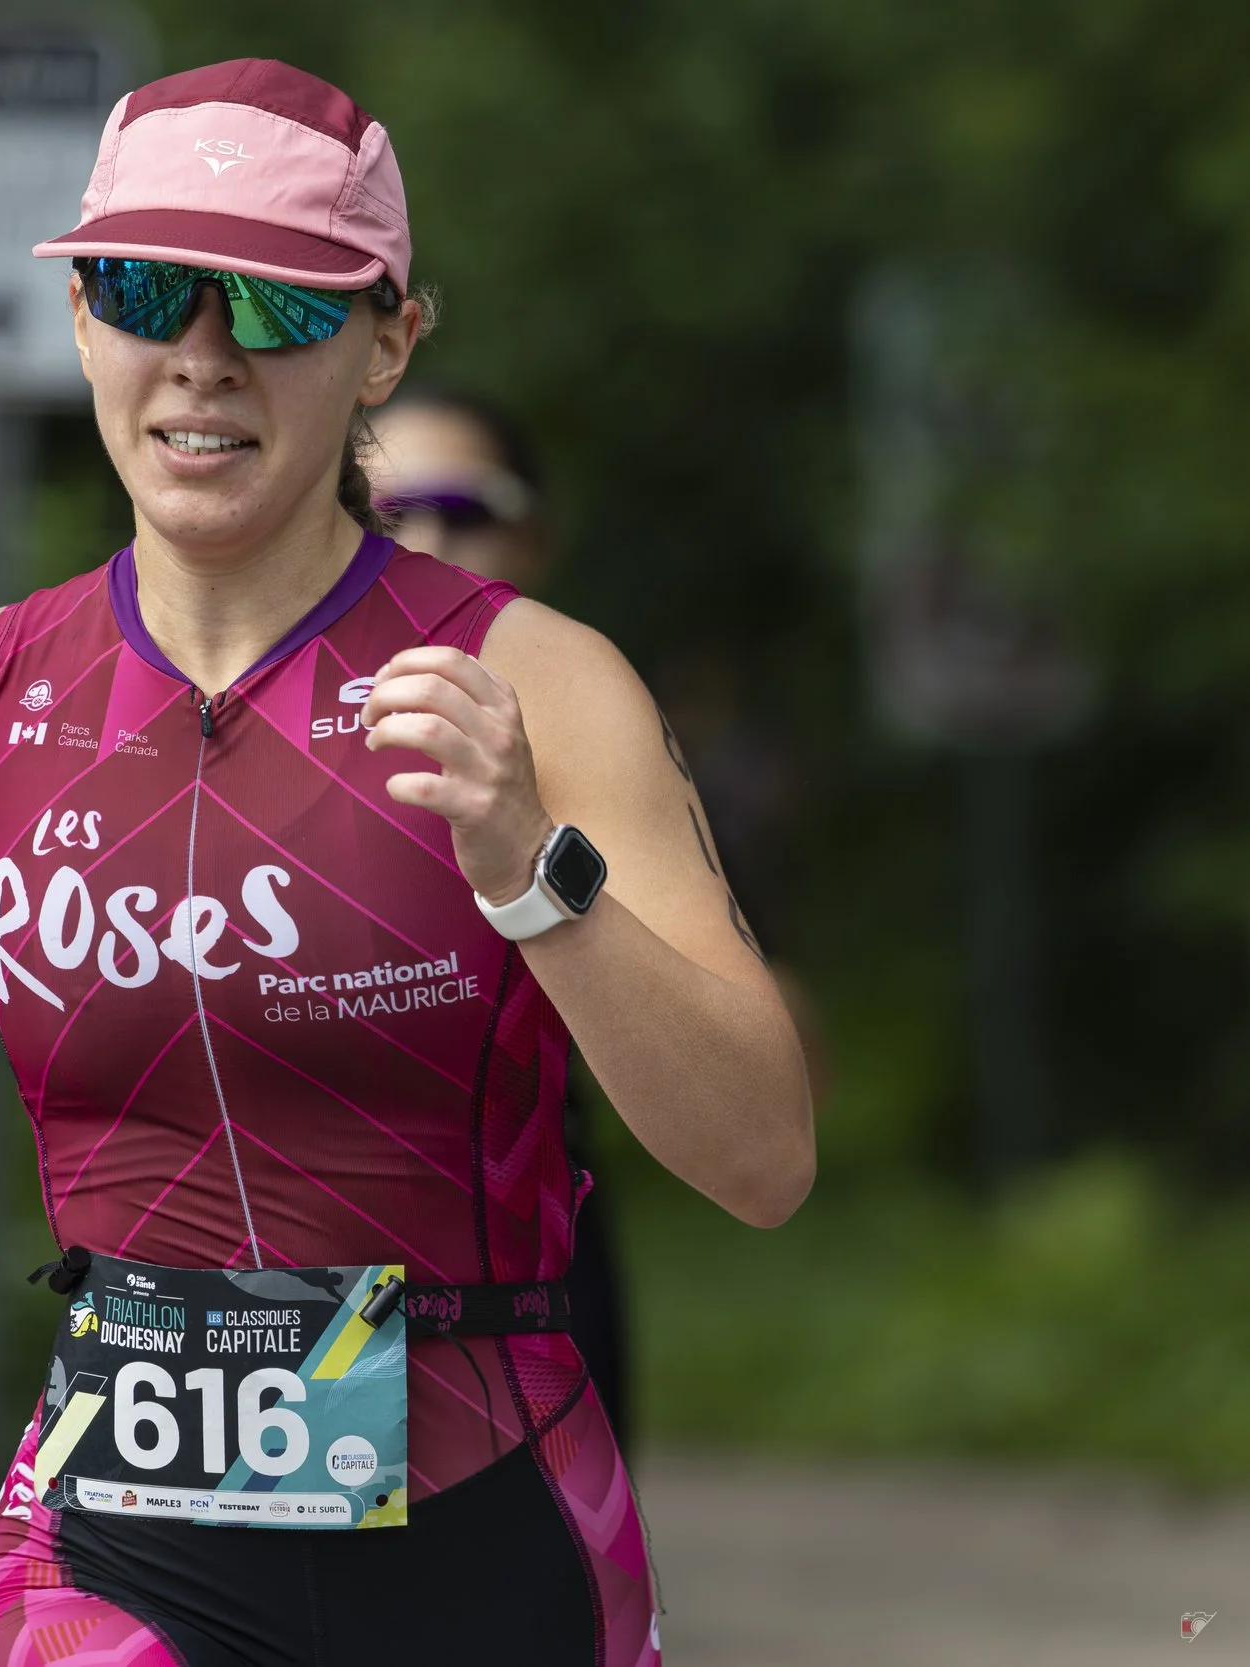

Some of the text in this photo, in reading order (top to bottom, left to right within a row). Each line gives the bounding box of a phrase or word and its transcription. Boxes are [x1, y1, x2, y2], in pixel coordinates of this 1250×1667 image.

[193, 138, 255, 160] KSL
[60, 722, 90, 736] Parcs
[117, 729, 149, 743] Parks
[57, 735, 99, 750] Canada
[115, 741, 159, 757] Canada
[258, 951, 460, 997] Parc national
[263, 974, 481, 1024] de la MAURICIE
[105, 1295, 186, 1331] TRIATHLON
[207, 1309, 301, 1327] LES CLASSIQUES
[100, 1320, 186, 1354] DUCHESNAY
[206, 1328, 301, 1353] CAPITALE
[113, 1361, 310, 1477] 616
[341, 1460, 375, 1470] CAPITALE
[84, 1490, 114, 1500] TRIATHLON
[146, 1497, 182, 1508] MAPLE3
[190, 1500, 209, 1508] PCN
[218, 1503, 261, 1512] YESTERDAY
[307, 1506, 347, 1514] LE SUBTIL
